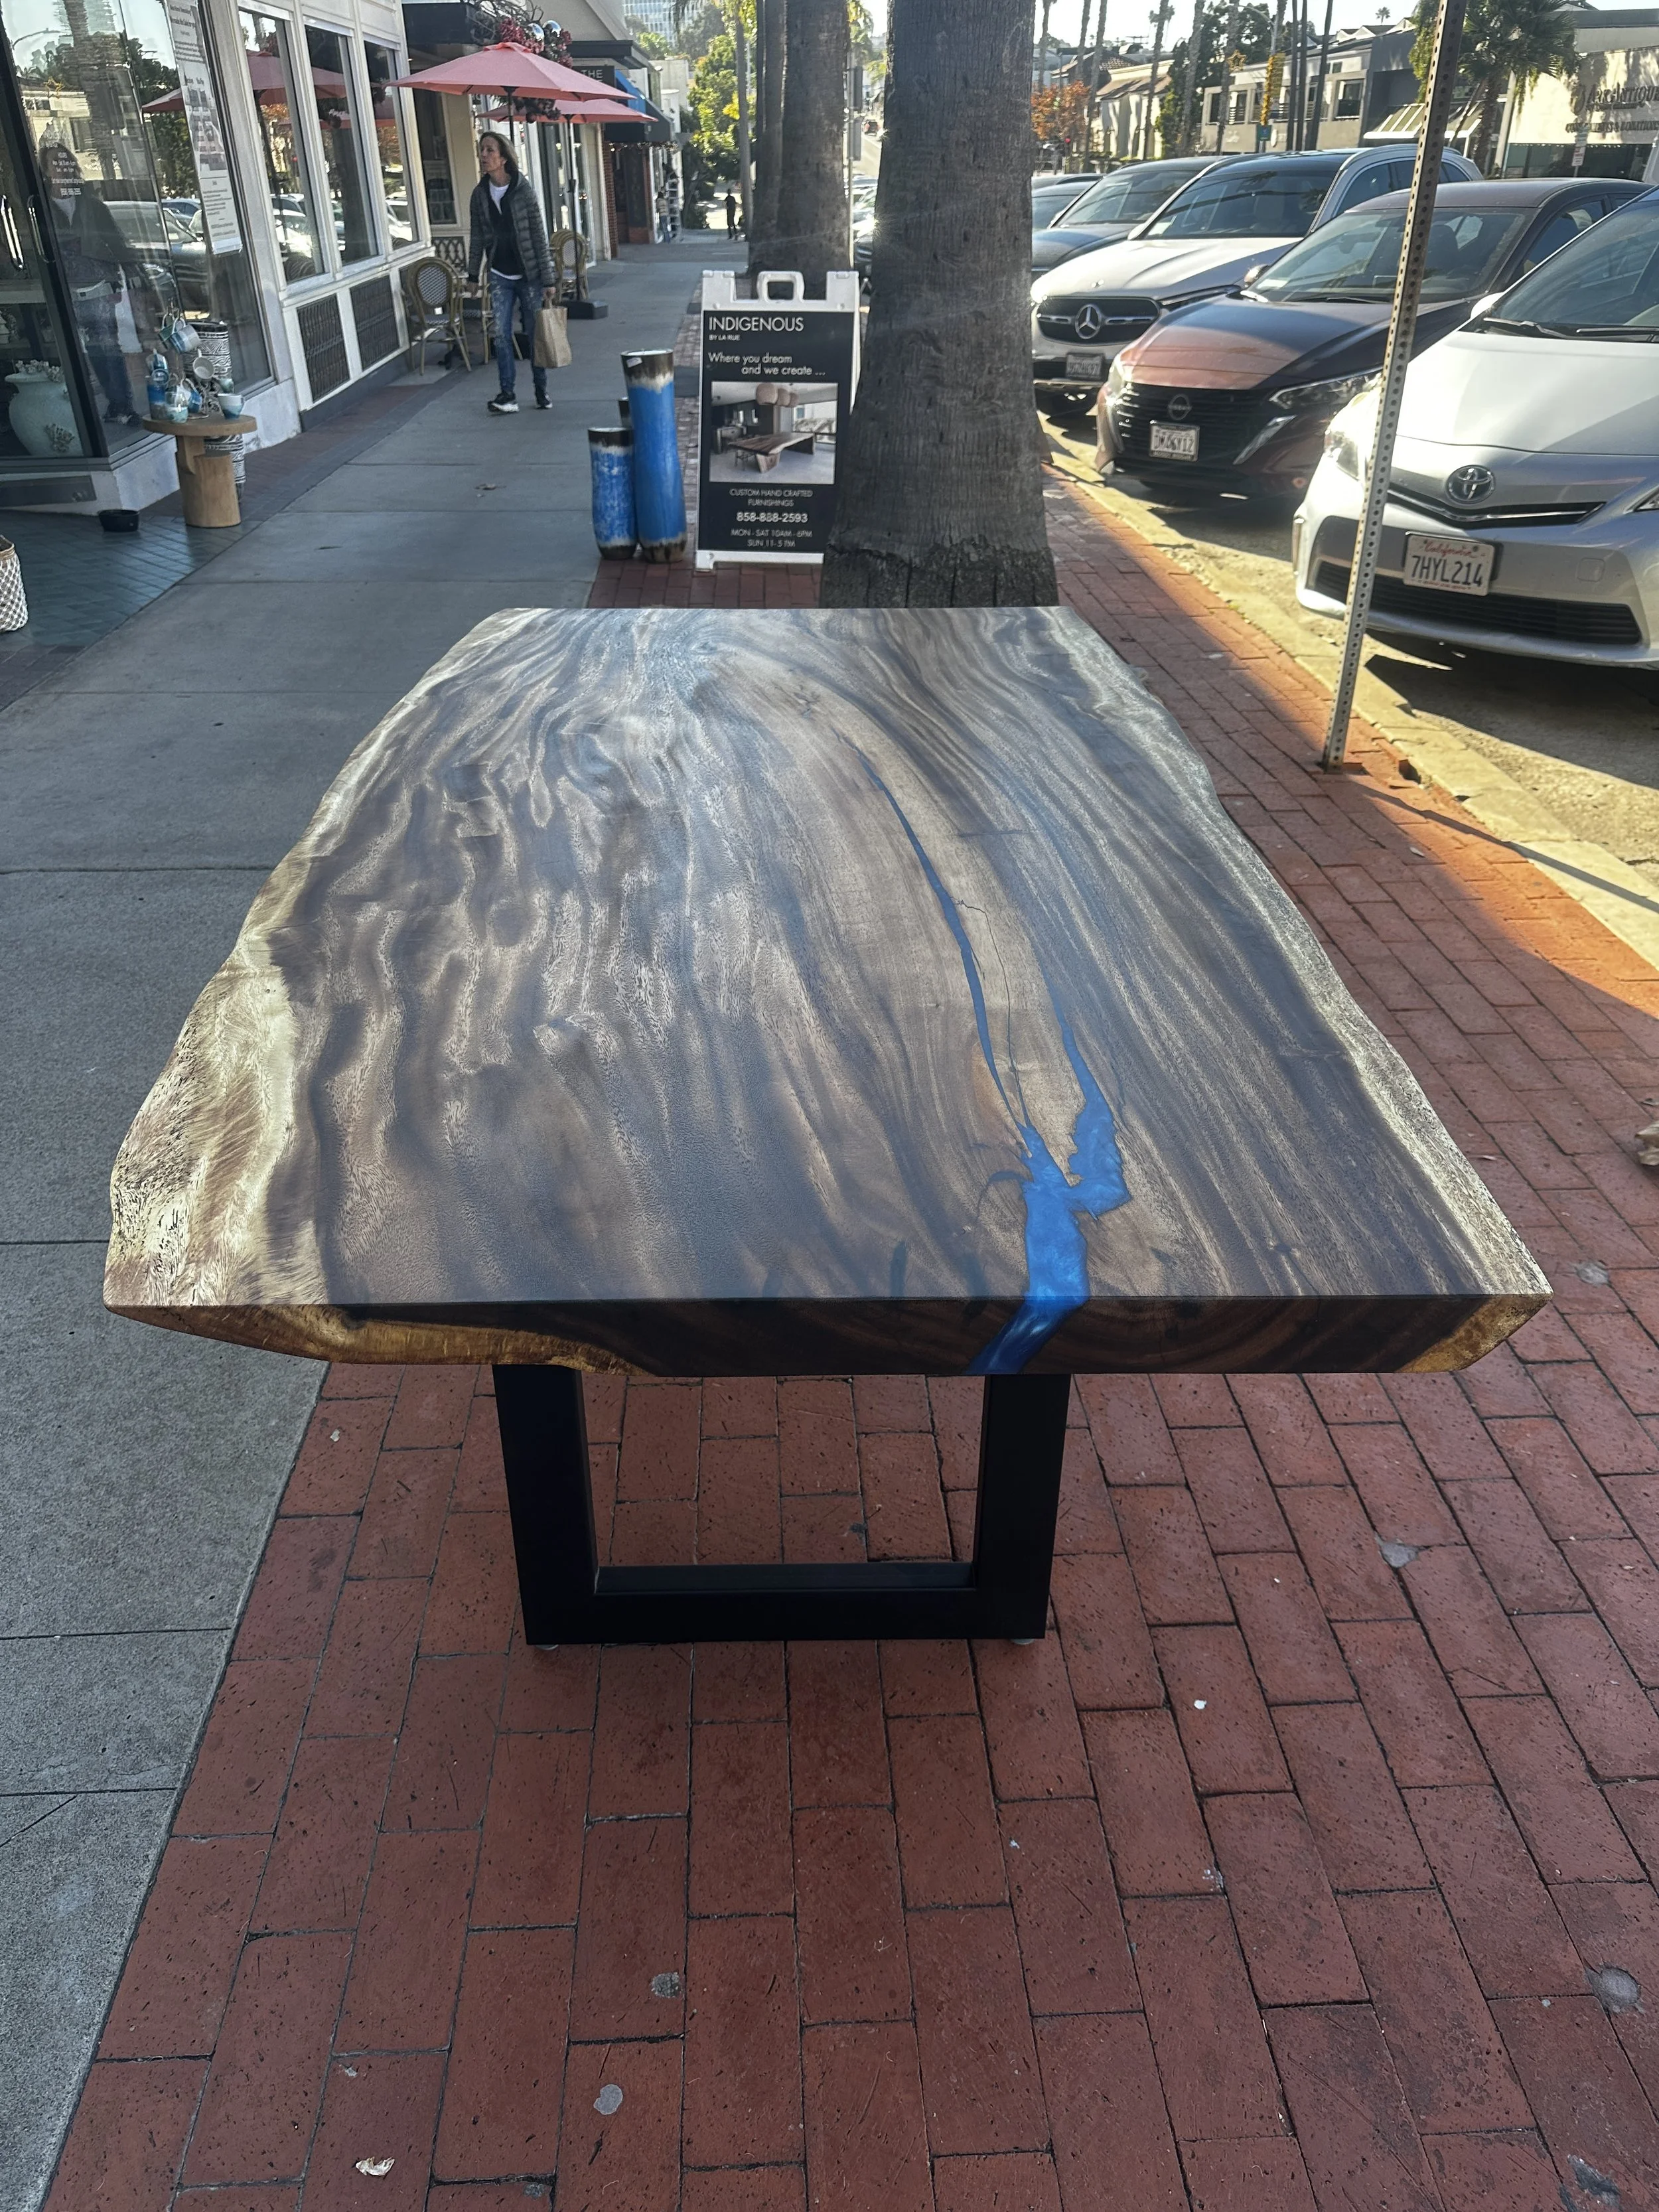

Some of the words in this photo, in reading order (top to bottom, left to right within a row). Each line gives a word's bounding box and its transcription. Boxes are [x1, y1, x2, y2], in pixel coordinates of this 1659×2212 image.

[581, 70, 603, 78] THE
[709, 317, 804, 331] INDIGENOUS
[708, 352, 741, 363] Where
[742, 355, 760, 365] you
[762, 352, 792, 364] dream
[741, 364, 761, 375] and
[781, 366, 812, 376] create
[1425, 540, 1477, 557] California
[1411, 555, 1482, 587] 7HYL214
